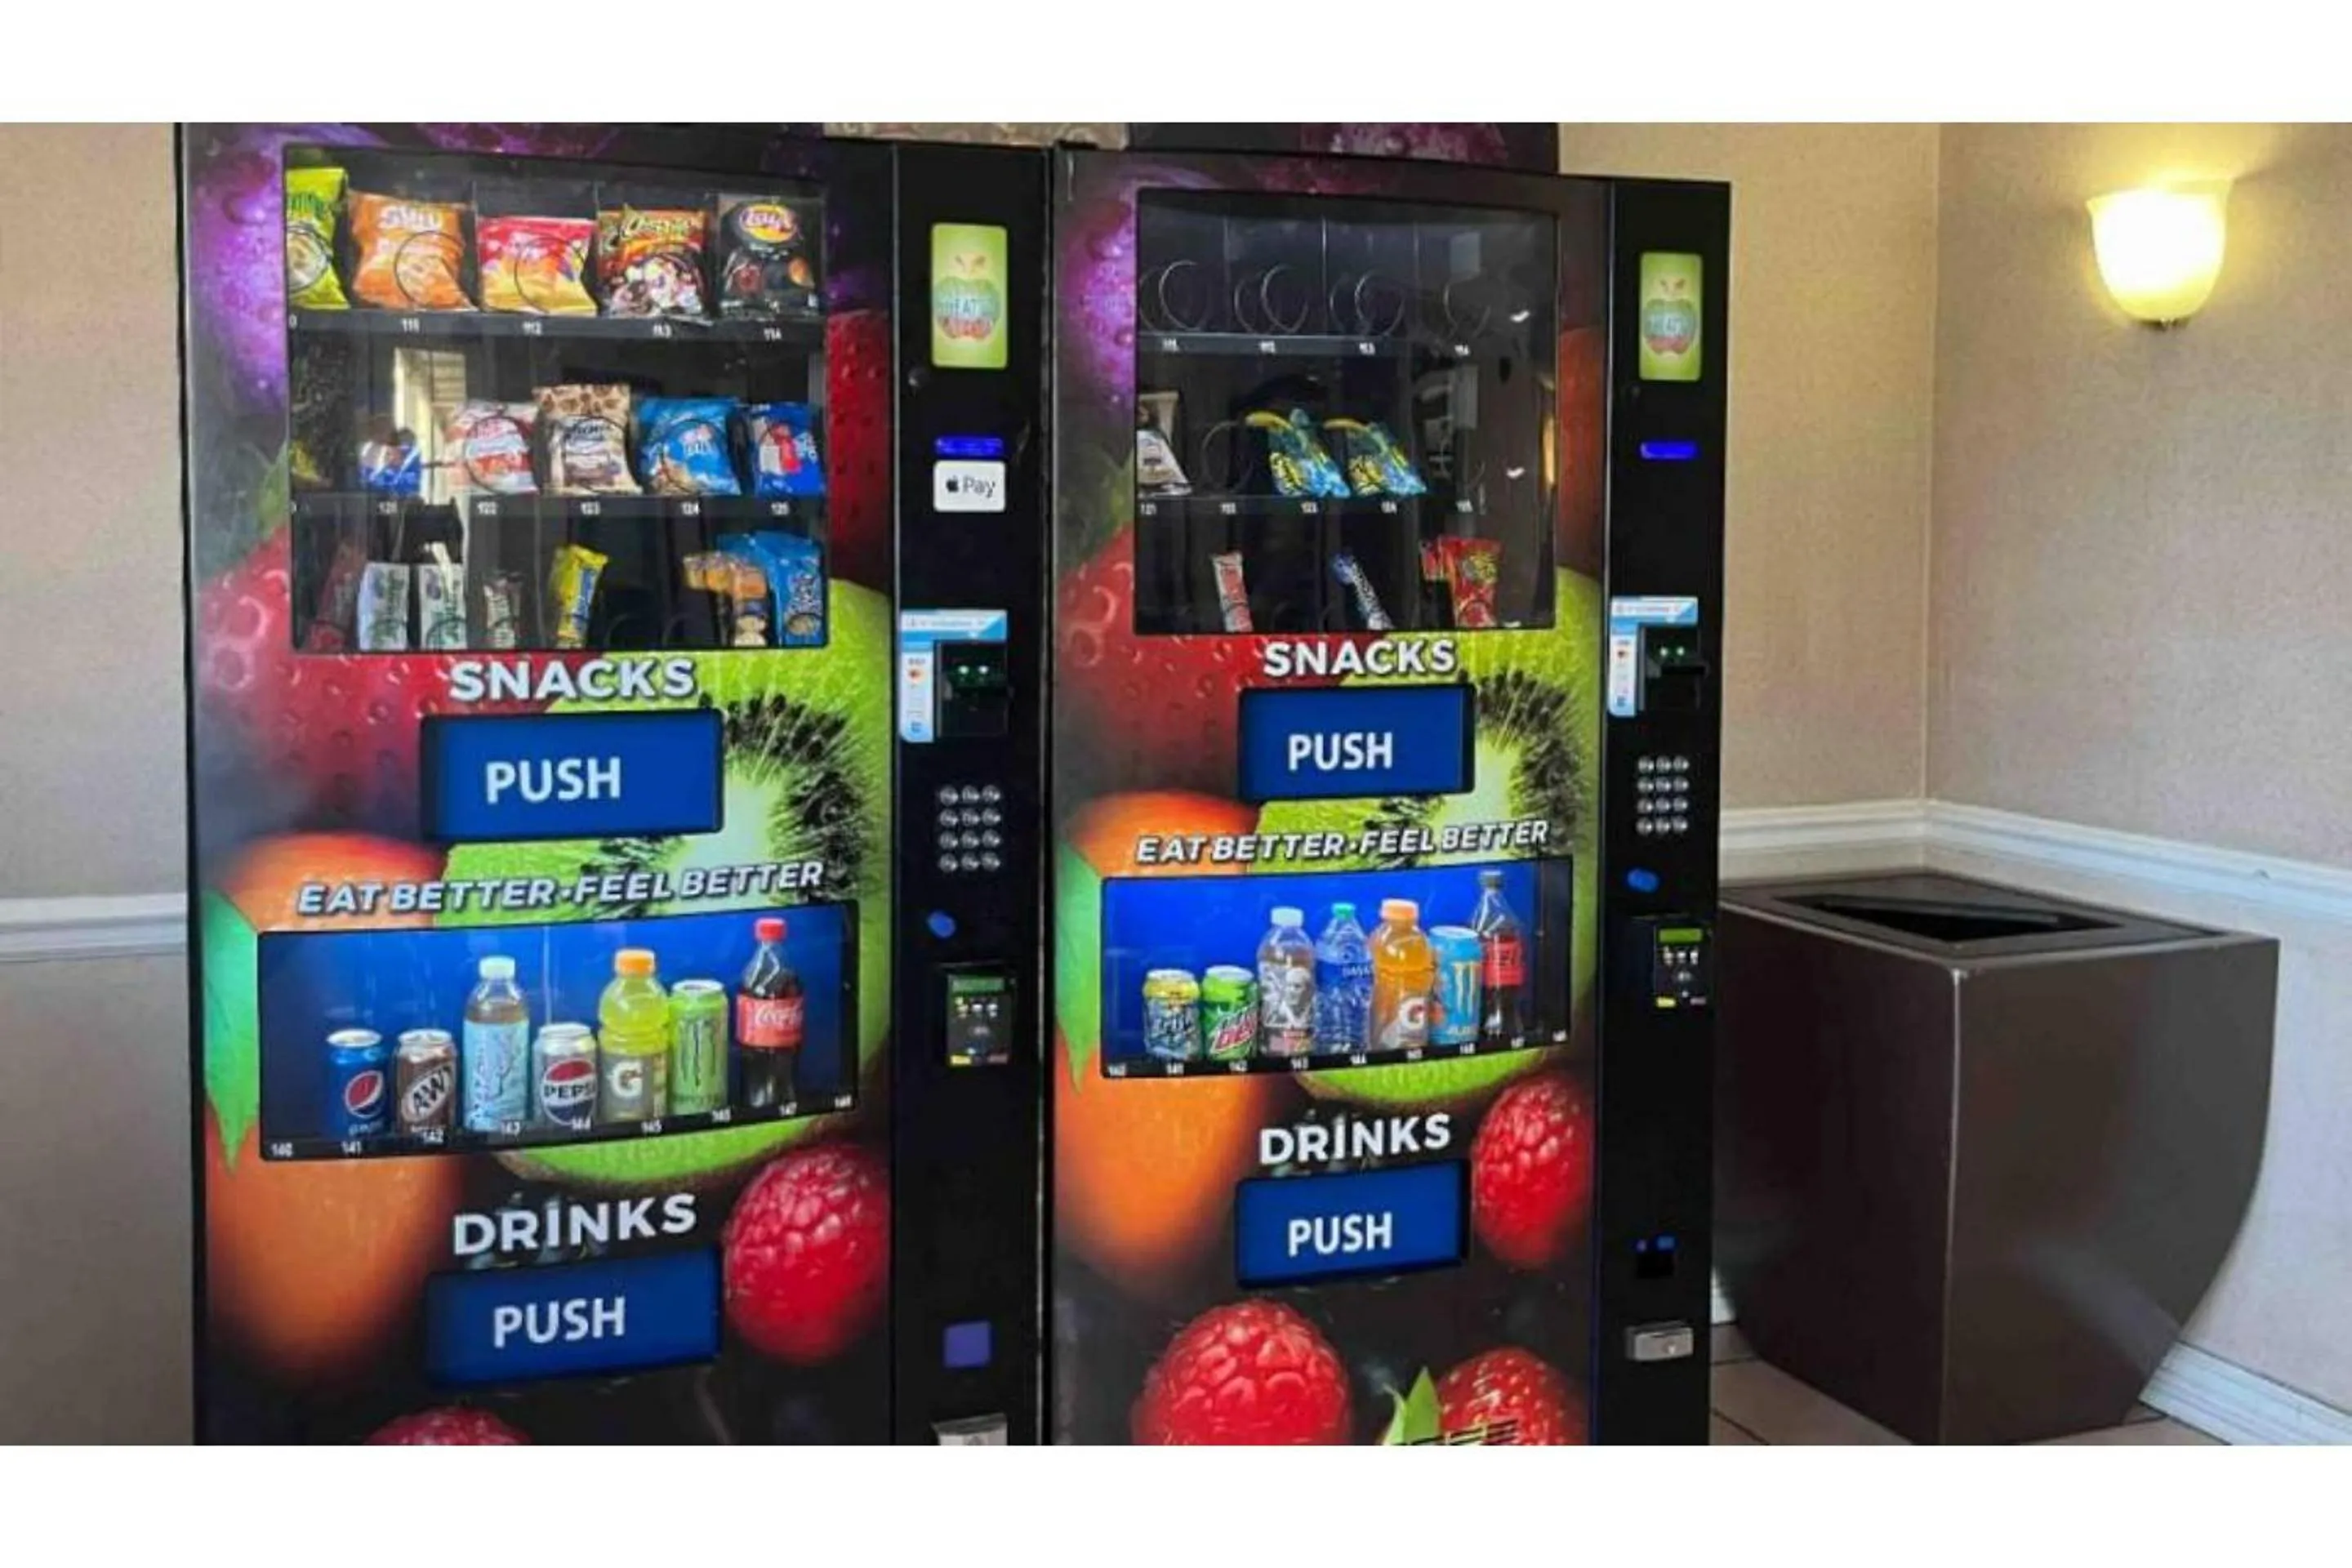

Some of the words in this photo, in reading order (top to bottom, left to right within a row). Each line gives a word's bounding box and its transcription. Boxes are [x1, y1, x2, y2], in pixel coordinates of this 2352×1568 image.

[963, 475, 996, 498] Pay
[448, 659, 696, 702] SNACKS
[1263, 640, 1455, 677] SNACKS
[1288, 732, 1393, 771] PUSH
[486, 757, 621, 804] PUSH
[1136, 835, 1208, 862] EAT
[1442, 819, 1549, 846] BETTER
[297, 883, 388, 915] EAT
[679, 861, 823, 894] BETTER
[608, 1062, 643, 1098] G
[1259, 1113, 1451, 1165] DRINKS
[453, 1192, 697, 1255] DRINKS
[1288, 1211, 1393, 1257] PUSH
[492, 1296, 626, 1348] PUSH
